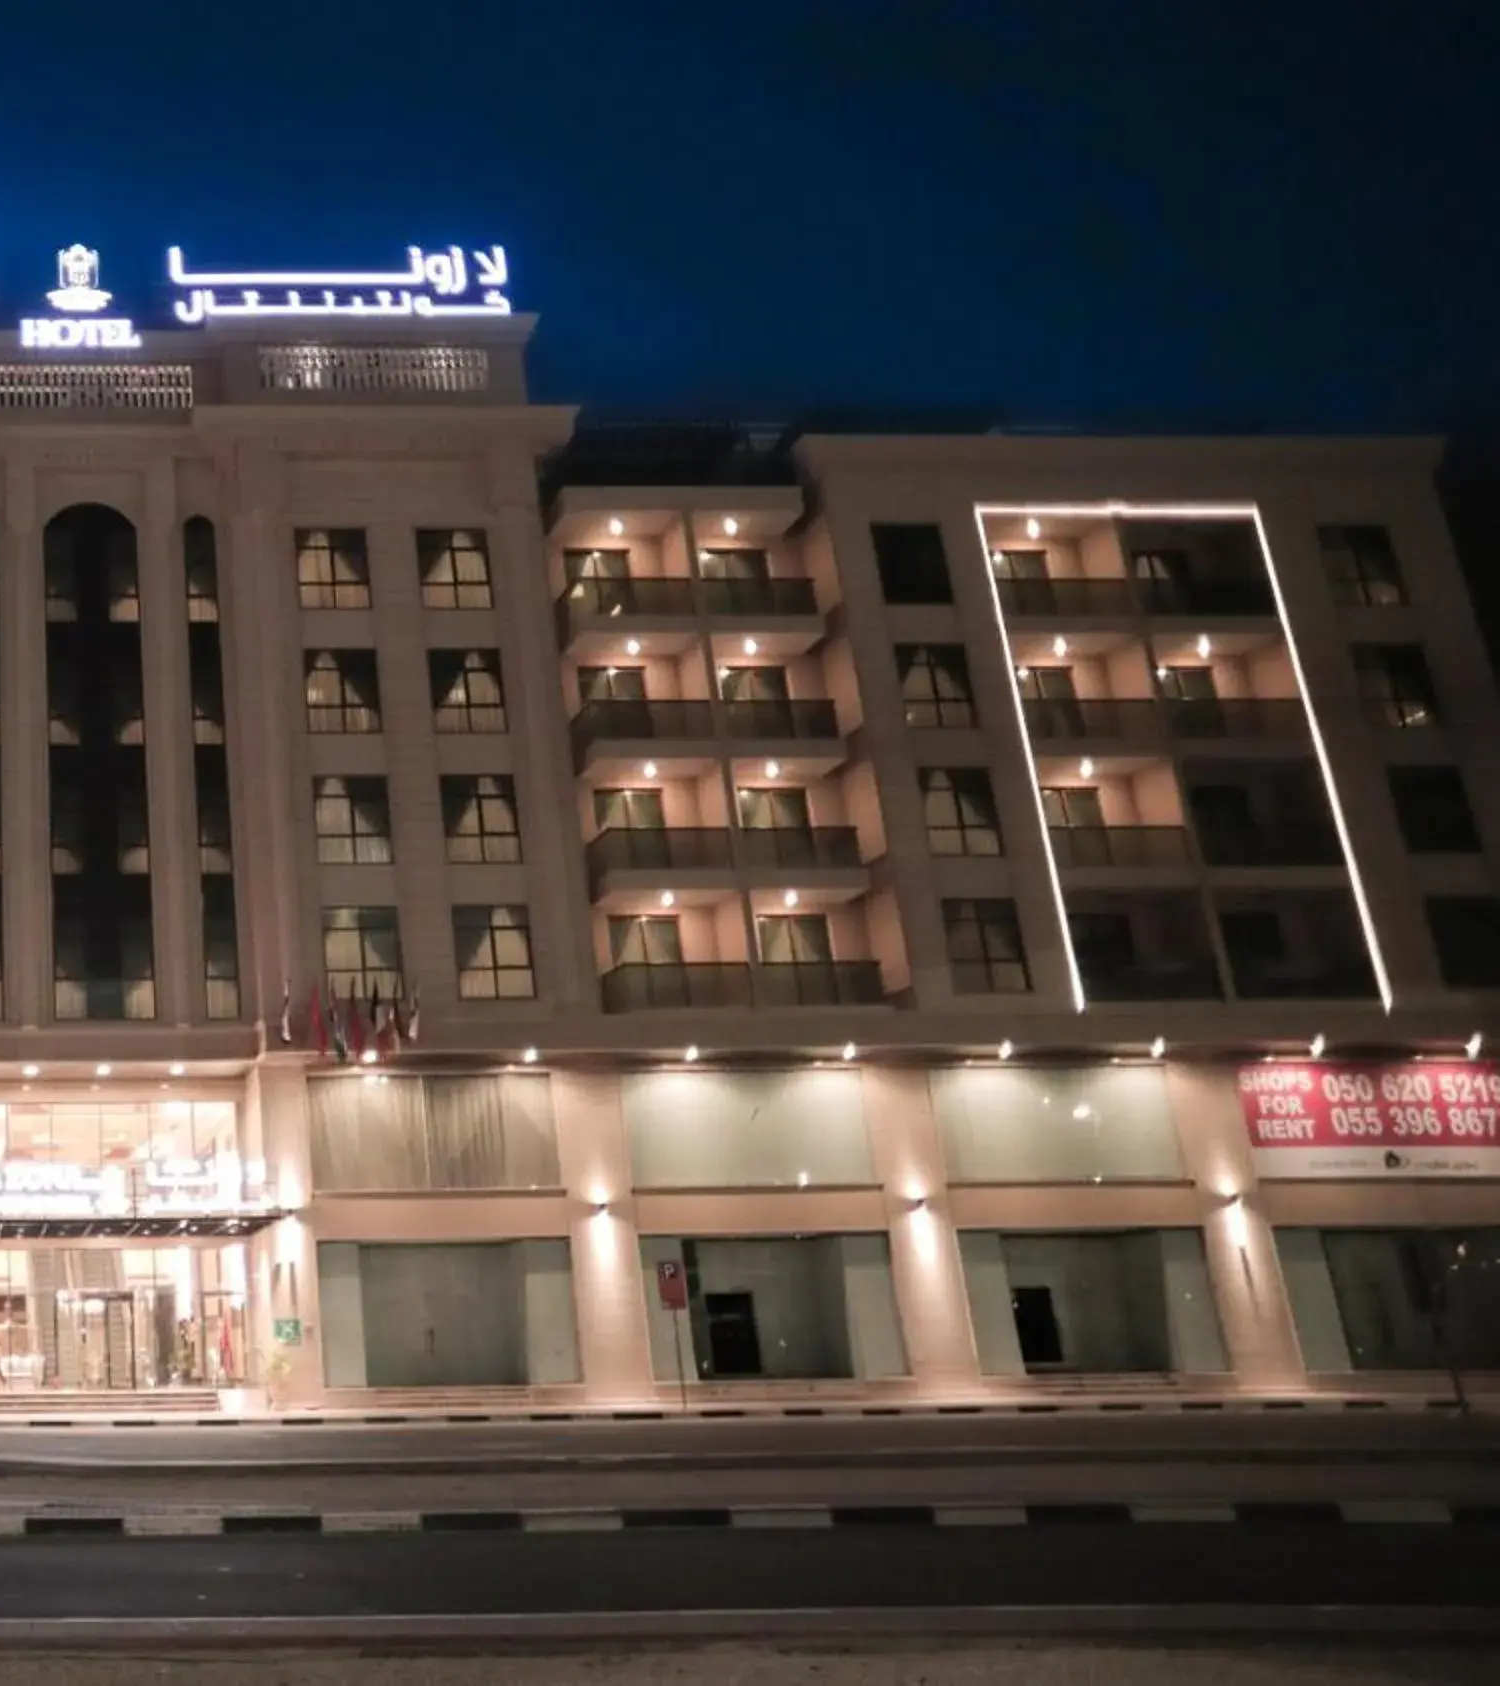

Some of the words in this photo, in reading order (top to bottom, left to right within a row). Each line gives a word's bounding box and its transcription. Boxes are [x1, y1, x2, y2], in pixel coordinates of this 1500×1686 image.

[19, 318, 143, 349] HOTEL
[1237, 1070, 1313, 1093] SHOPS
[1321, 1072, 1375, 1104] 050
[1380, 1072, 1435, 1103] 620
[1256, 1094, 1305, 1116] FOR
[1256, 1118, 1316, 1141] RENT
[1330, 1106, 1384, 1138] 055
[1389, 1106, 1443, 1137] 396
